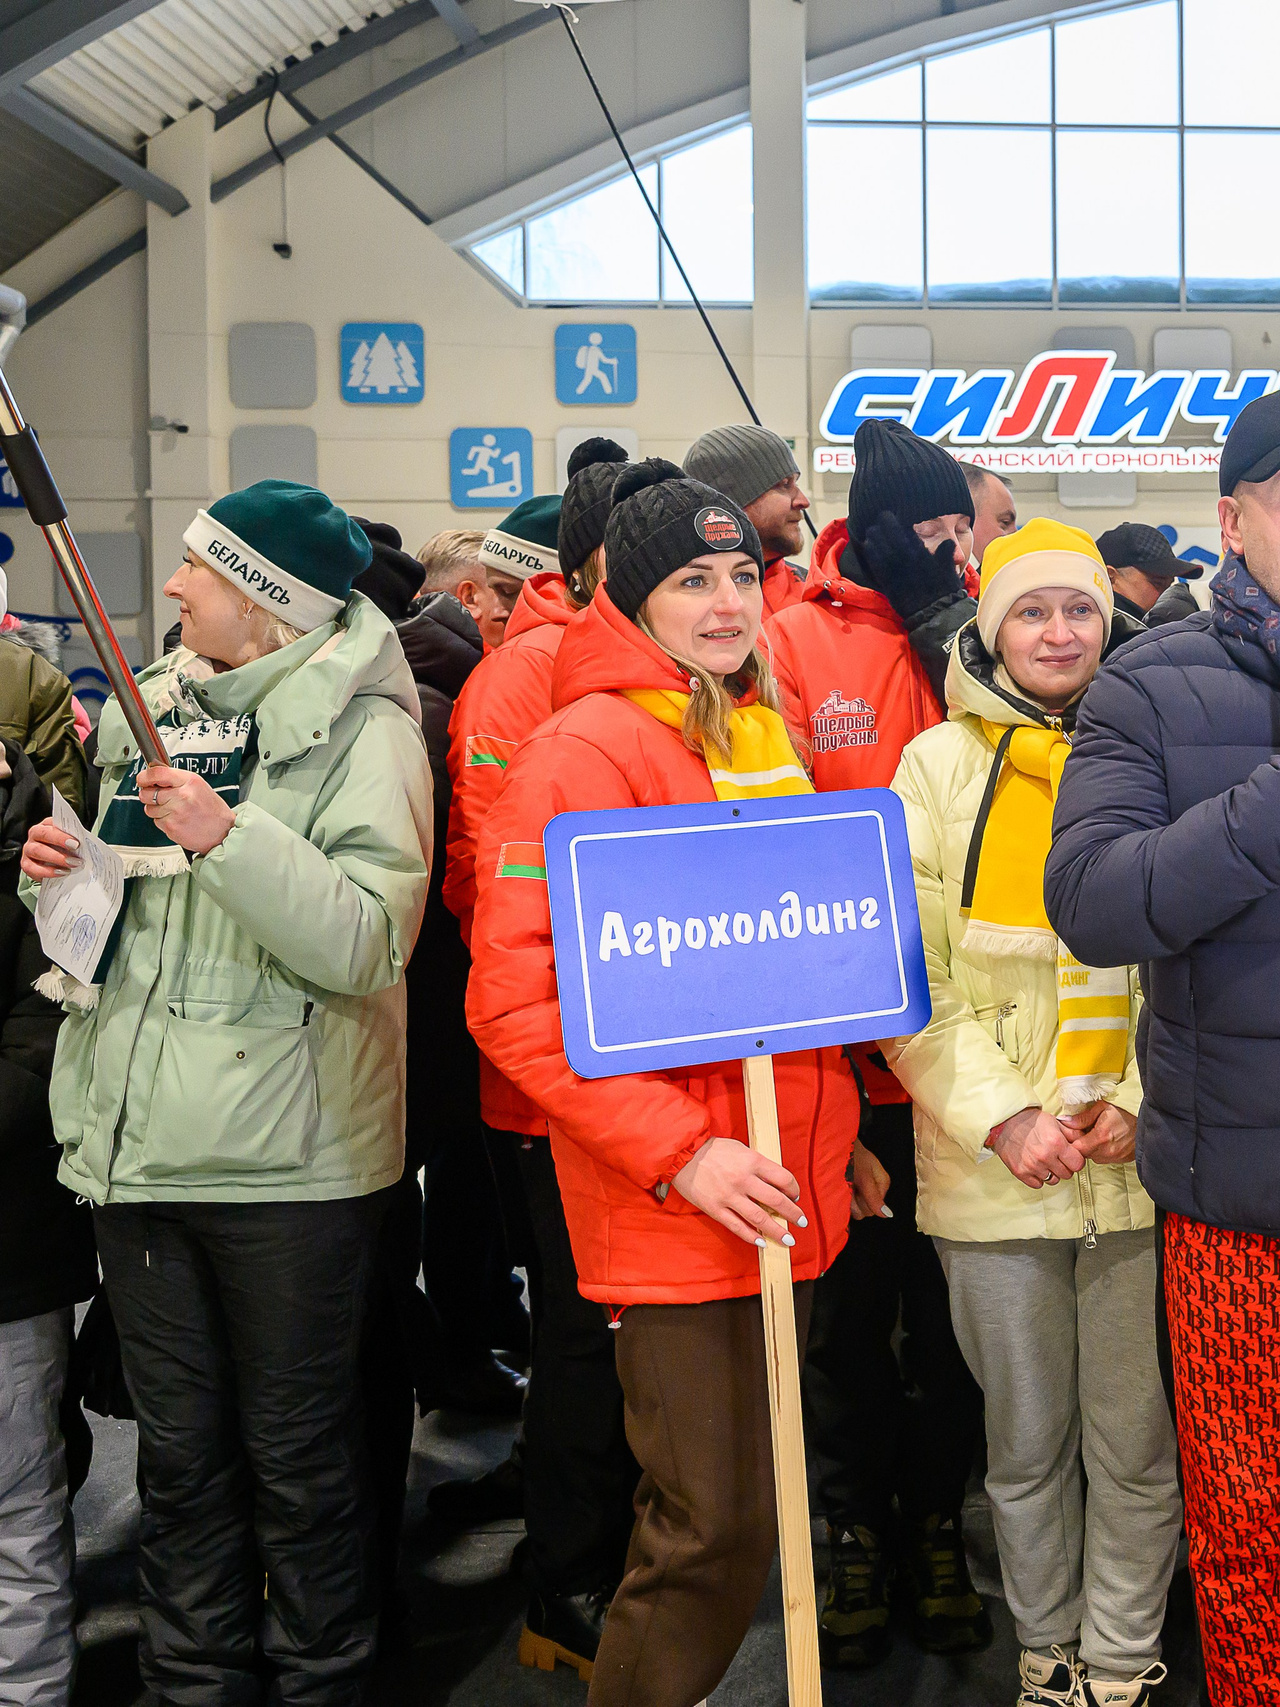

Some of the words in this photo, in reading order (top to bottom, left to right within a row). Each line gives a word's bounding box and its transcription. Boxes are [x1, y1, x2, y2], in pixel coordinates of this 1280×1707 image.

[1082, 453, 1220, 467] ГОРНОЛЫЖ
[483, 539, 544, 571] БЕЛАРУСЬ
[207, 539, 291, 605] БЕЛАРУСЬ
[814, 714, 875, 735] Щедрые
[812, 731, 878, 753] Пружаны
[598, 890, 882, 968] Агрохолдинг
[1057, 971, 1091, 989] ДИНГ
